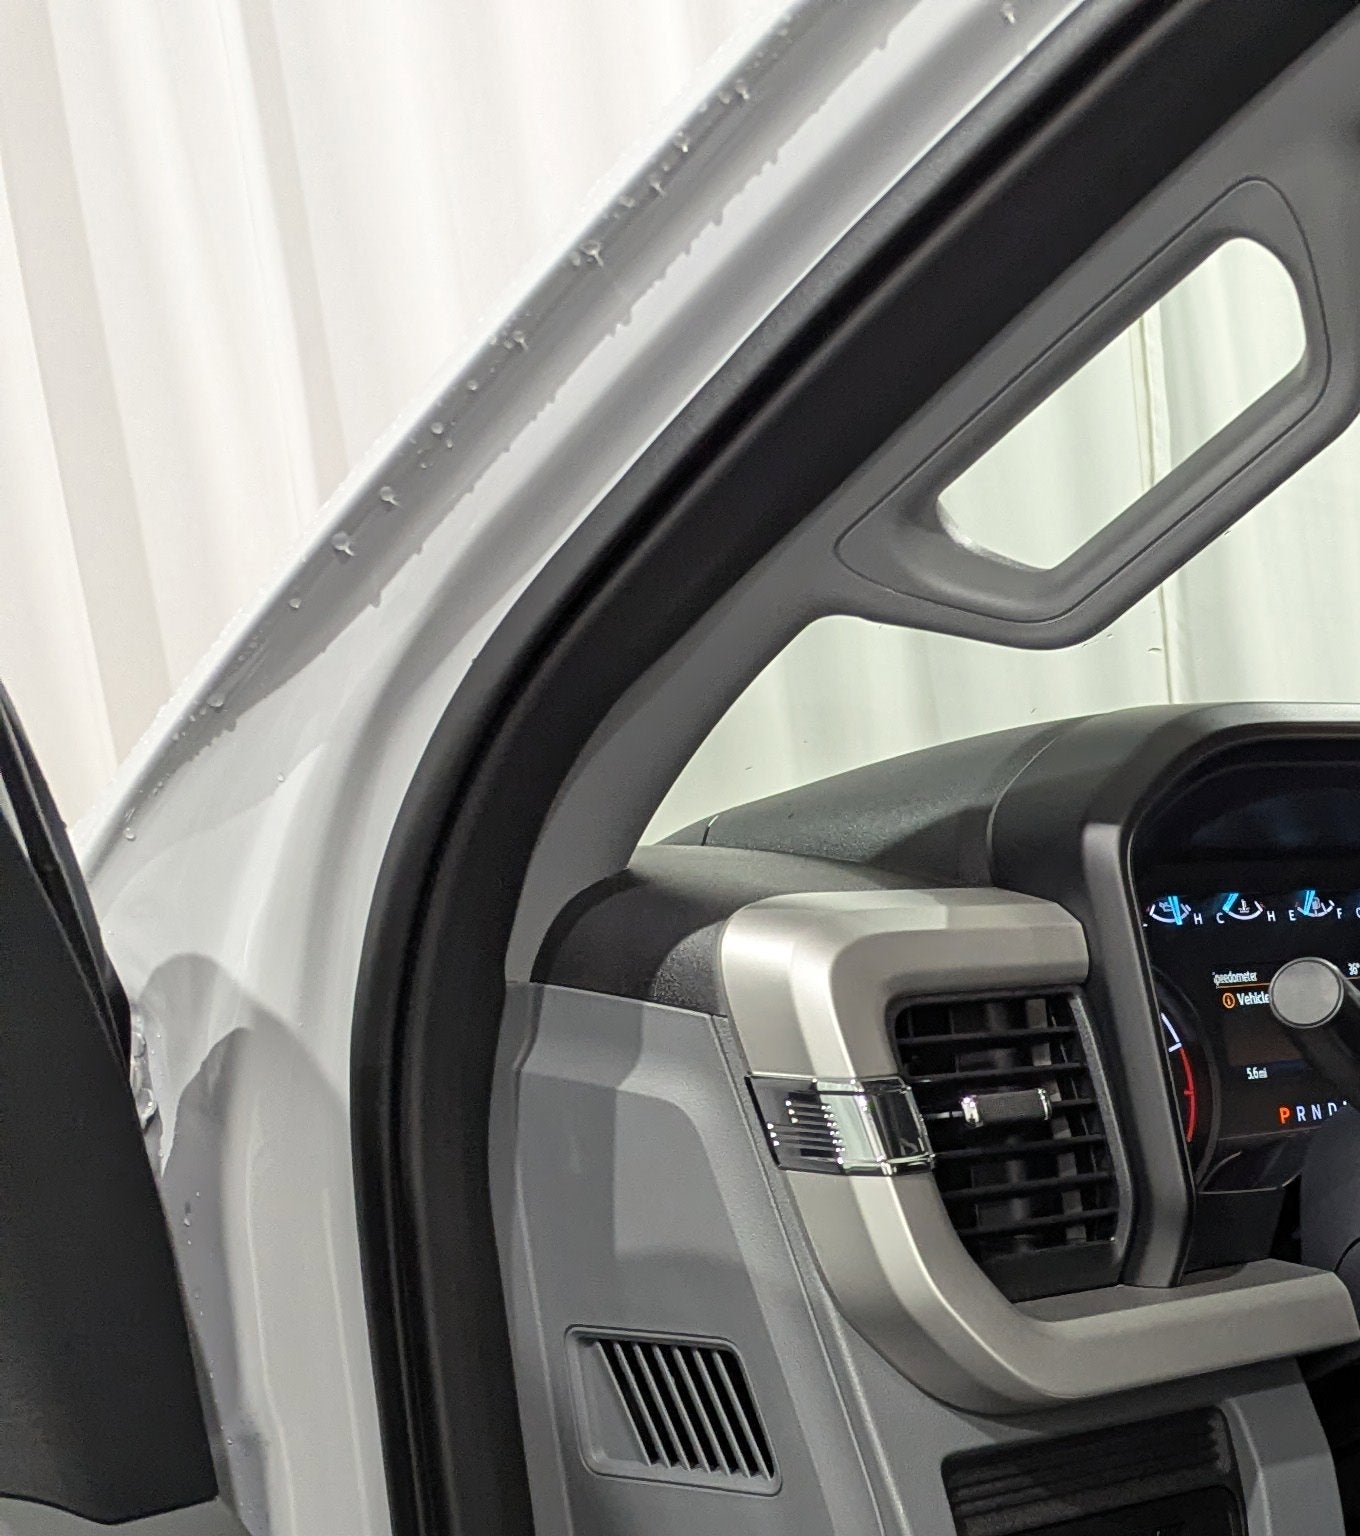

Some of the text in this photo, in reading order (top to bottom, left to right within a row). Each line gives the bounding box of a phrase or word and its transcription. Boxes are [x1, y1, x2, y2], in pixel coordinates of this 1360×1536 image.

[1194, 913, 1203, 925] H
[1216, 913, 1225, 924] C
[1267, 911, 1276, 922] H
[1289, 911, 1297, 921] E
[1337, 909, 1343, 919] F
[1279, 1107, 1290, 1124] P
[1296, 1105, 1306, 1122] R
[1311, 1104, 1322, 1120] N
